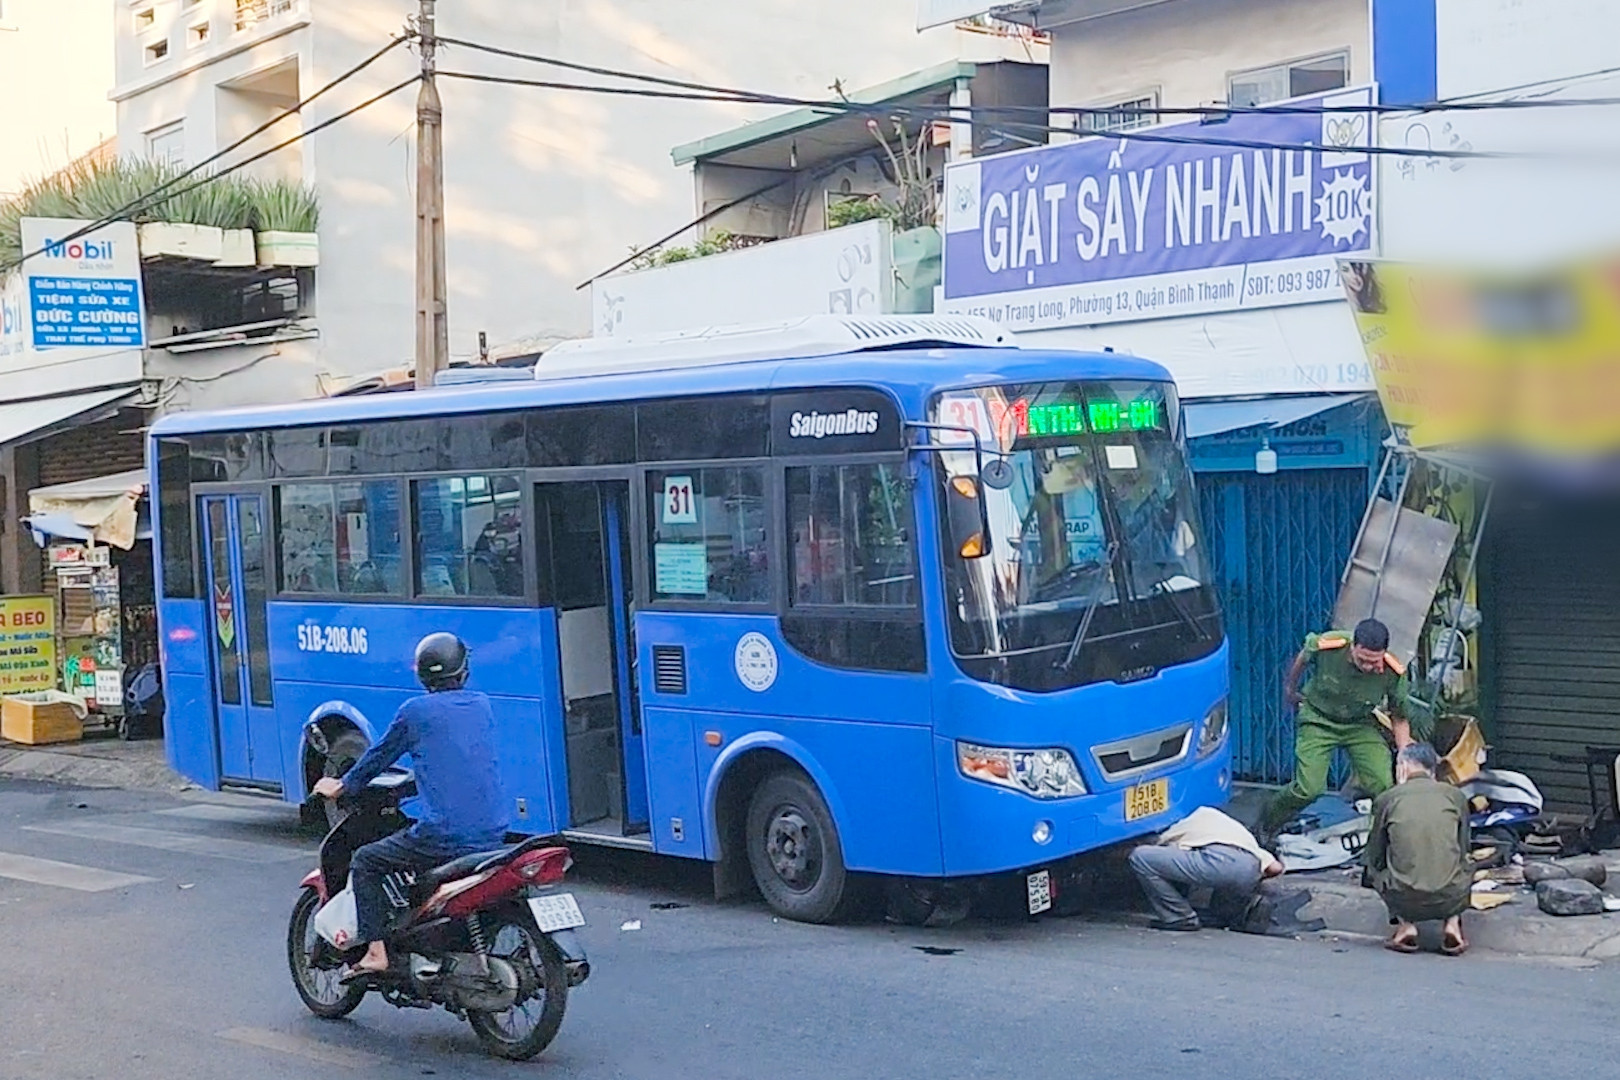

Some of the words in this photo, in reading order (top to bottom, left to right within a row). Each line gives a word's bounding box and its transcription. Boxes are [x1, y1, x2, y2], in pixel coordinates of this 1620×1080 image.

[983, 163, 1066, 285] GIẶT
[1076, 139, 1154, 261] SẤY
[1165, 142, 1312, 248] NHANH
[1325, 187, 1363, 223] 10K
[45, 239, 112, 259] Mobil
[37, 294, 74, 305] TIỆM
[112, 296, 130, 306] XE
[1005, 304, 1035, 324] Trang
[1038, 300, 1066, 320] Long,
[1069, 295, 1112, 316] Phường
[1116, 290, 1132, 312] 13,
[1136, 286, 1165, 312] Quận
[1169, 282, 1194, 305] Bình
[1198, 279, 1234, 304] Thạnh
[1247, 274, 1273, 296] SĐT:
[1278, 271, 1302, 293] 093
[1306, 269, 1331, 290] 987
[35, 308, 73, 324] ĐỨC
[78, 308, 138, 324] CƯỜNG
[1337, 362, 1370, 383] 194
[789, 408, 879, 439] SaigonBus
[950, 400, 980, 438] 31
[668, 485, 690, 515] 31
[13, 610, 45, 627] BEO
[297, 624, 369, 655] 51B-208.06
[1130, 796, 1165, 820] 208.06
